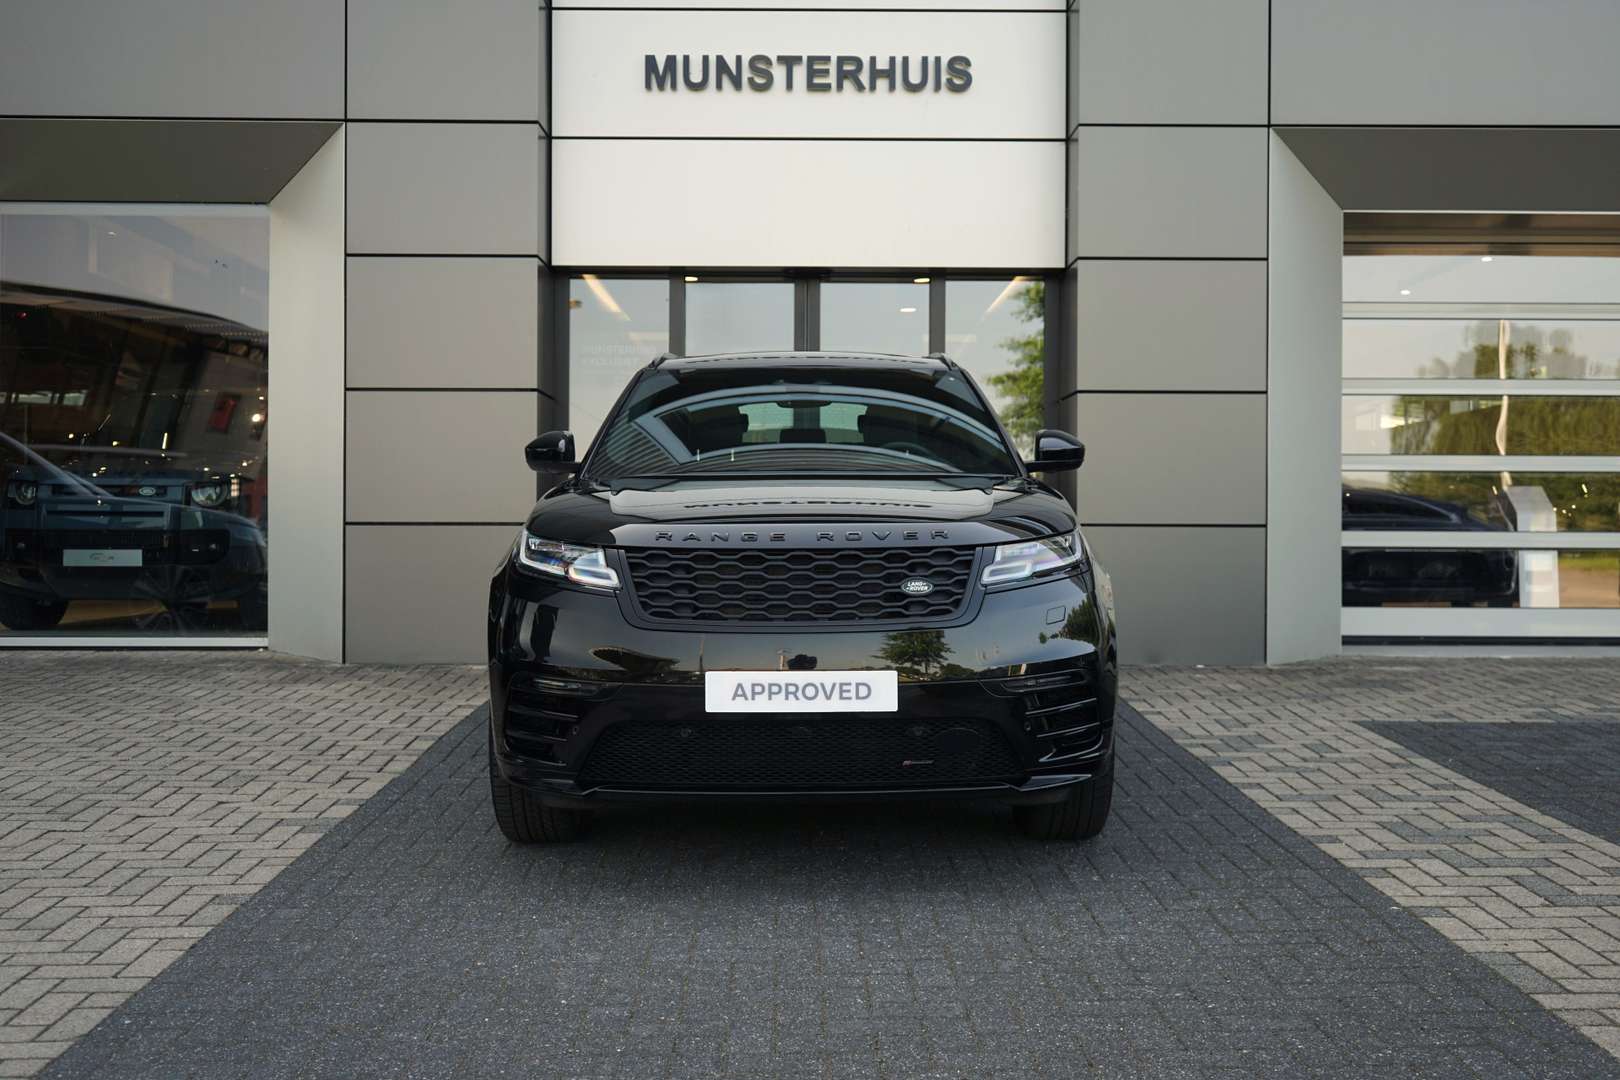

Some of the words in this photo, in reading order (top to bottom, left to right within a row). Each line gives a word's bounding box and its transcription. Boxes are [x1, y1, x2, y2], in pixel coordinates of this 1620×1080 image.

[644, 54, 973, 93] MUNSTERHUIS
[655, 530, 786, 542] RANGE
[816, 529, 949, 542] ROVER
[731, 682, 872, 701] APPROVED
